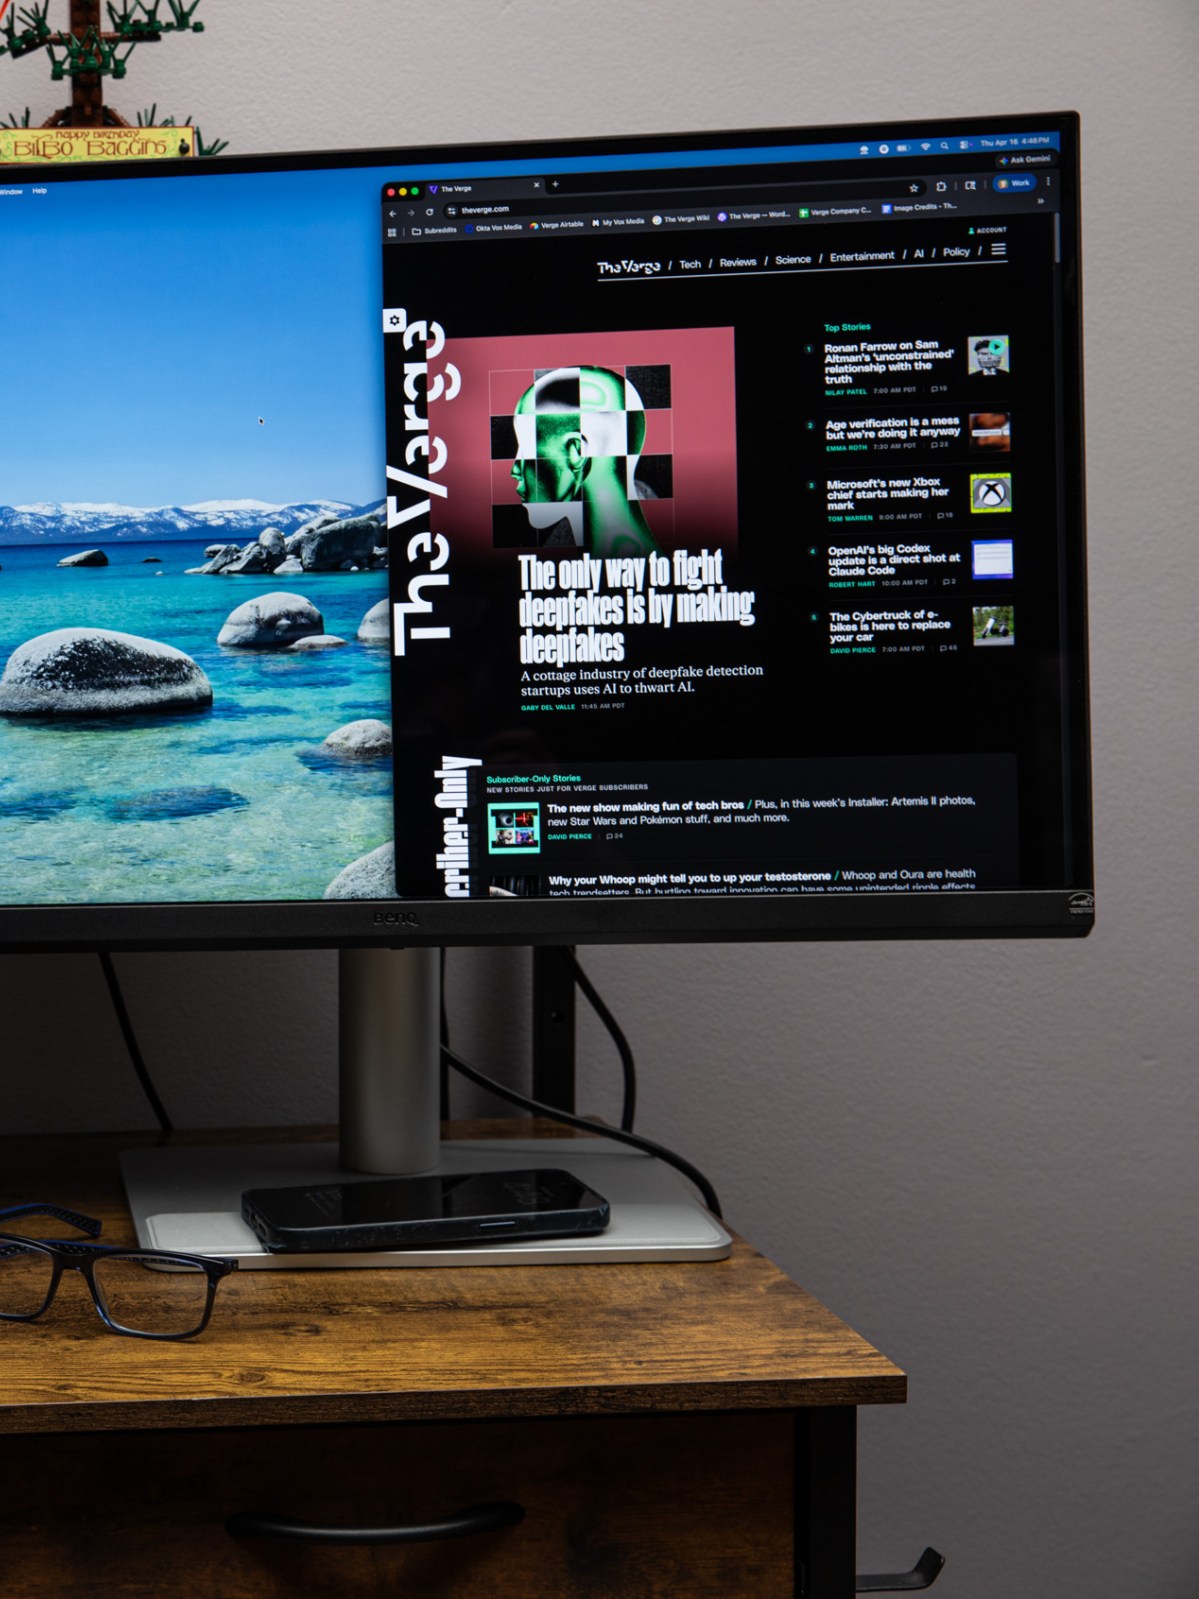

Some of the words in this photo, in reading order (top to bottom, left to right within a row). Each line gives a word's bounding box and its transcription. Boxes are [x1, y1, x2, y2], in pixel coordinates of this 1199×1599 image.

[1025, 154, 1050, 163] Gemini
[32, 187, 47, 195] Help
[453, 185, 472, 193] Verge
[461, 205, 509, 215] theverge.com
[679, 259, 701, 269] Tech
[719, 256, 757, 267] Reviews
[775, 254, 812, 264] Science
[829, 250, 895, 262] Entertainment
[913, 248, 924, 258] AI
[943, 246, 970, 258] Policy
[824, 323, 840, 333] Top
[841, 322, 871, 331] Stories
[824, 343, 858, 353] Ronan
[860, 341, 897, 351] Farrow
[899, 342, 913, 350] on
[915, 339, 939, 349] Sam
[824, 362, 885, 376] relationship
[889, 361, 911, 371] with
[915, 360, 932, 370] the
[824, 374, 852, 384] truth
[825, 419, 846, 431] Age
[849, 416, 907, 428] verification
[910, 416, 919, 426] is
[922, 418, 928, 426] a
[931, 417, 960, 425] mess
[825, 430, 844, 440] but
[878, 427, 907, 440] doing
[910, 427, 917, 437] it
[920, 427, 961, 438] anyway
[889, 479, 911, 487] new
[914, 476, 940, 486] Xbox
[826, 489, 854, 502] chief
[855, 489, 888, 499] starts
[889, 487, 930, 499] making
[930, 486, 949, 496] her
[827, 500, 854, 510] mark
[877, 544, 895, 556] big
[896, 543, 930, 555] Codex
[828, 555, 866, 568] update
[868, 555, 878, 567] is
[879, 556, 887, 564] a
[888, 554, 920, 564] direct
[922, 553, 946, 563] shot
[949, 553, 961, 562] at
[517, 553, 556, 591] The
[558, 551, 603, 594] only
[605, 557, 646, 593] way
[648, 549, 670, 587] to
[672, 548, 724, 591] fight
[828, 565, 864, 576] Claude
[868, 565, 896, 575] Code
[518, 588, 624, 632] deepfakes
[626, 587, 646, 624] is
[647, 587, 674, 629] by
[676, 584, 756, 628] making
[829, 611, 850, 621] The
[851, 609, 912, 622] Cybertruck
[913, 609, 925, 619] of
[829, 621, 857, 632] bikes
[860, 621, 869, 631] is
[871, 620, 895, 631] here
[898, 620, 909, 630] to
[912, 619, 951, 631] replace
[829, 634, 853, 644] your
[856, 633, 874, 641] car
[519, 625, 625, 669] deepfakes
[520, 670, 530, 681] A
[533, 670, 576, 683] cottage
[580, 667, 629, 682] industry
[633, 667, 646, 678] of
[648, 665, 703, 680] deepfake
[706, 663, 763, 676] detection
[521, 685, 570, 698] startups
[574, 685, 599, 695] uses
[602, 683, 616, 694] AI
[619, 684, 632, 694] to
[634, 681, 674, 693] thwart
[676, 680, 695, 692] AI.
[486, 774, 551, 785] Subscriber-Only
[552, 774, 581, 782] Stories
[547, 803, 566, 813] The
[593, 802, 620, 812] show
[623, 801, 659, 813] making
[662, 801, 679, 811] fun
[682, 800, 692, 810] of
[695, 800, 718, 810] tech
[721, 799, 745, 809] bros
